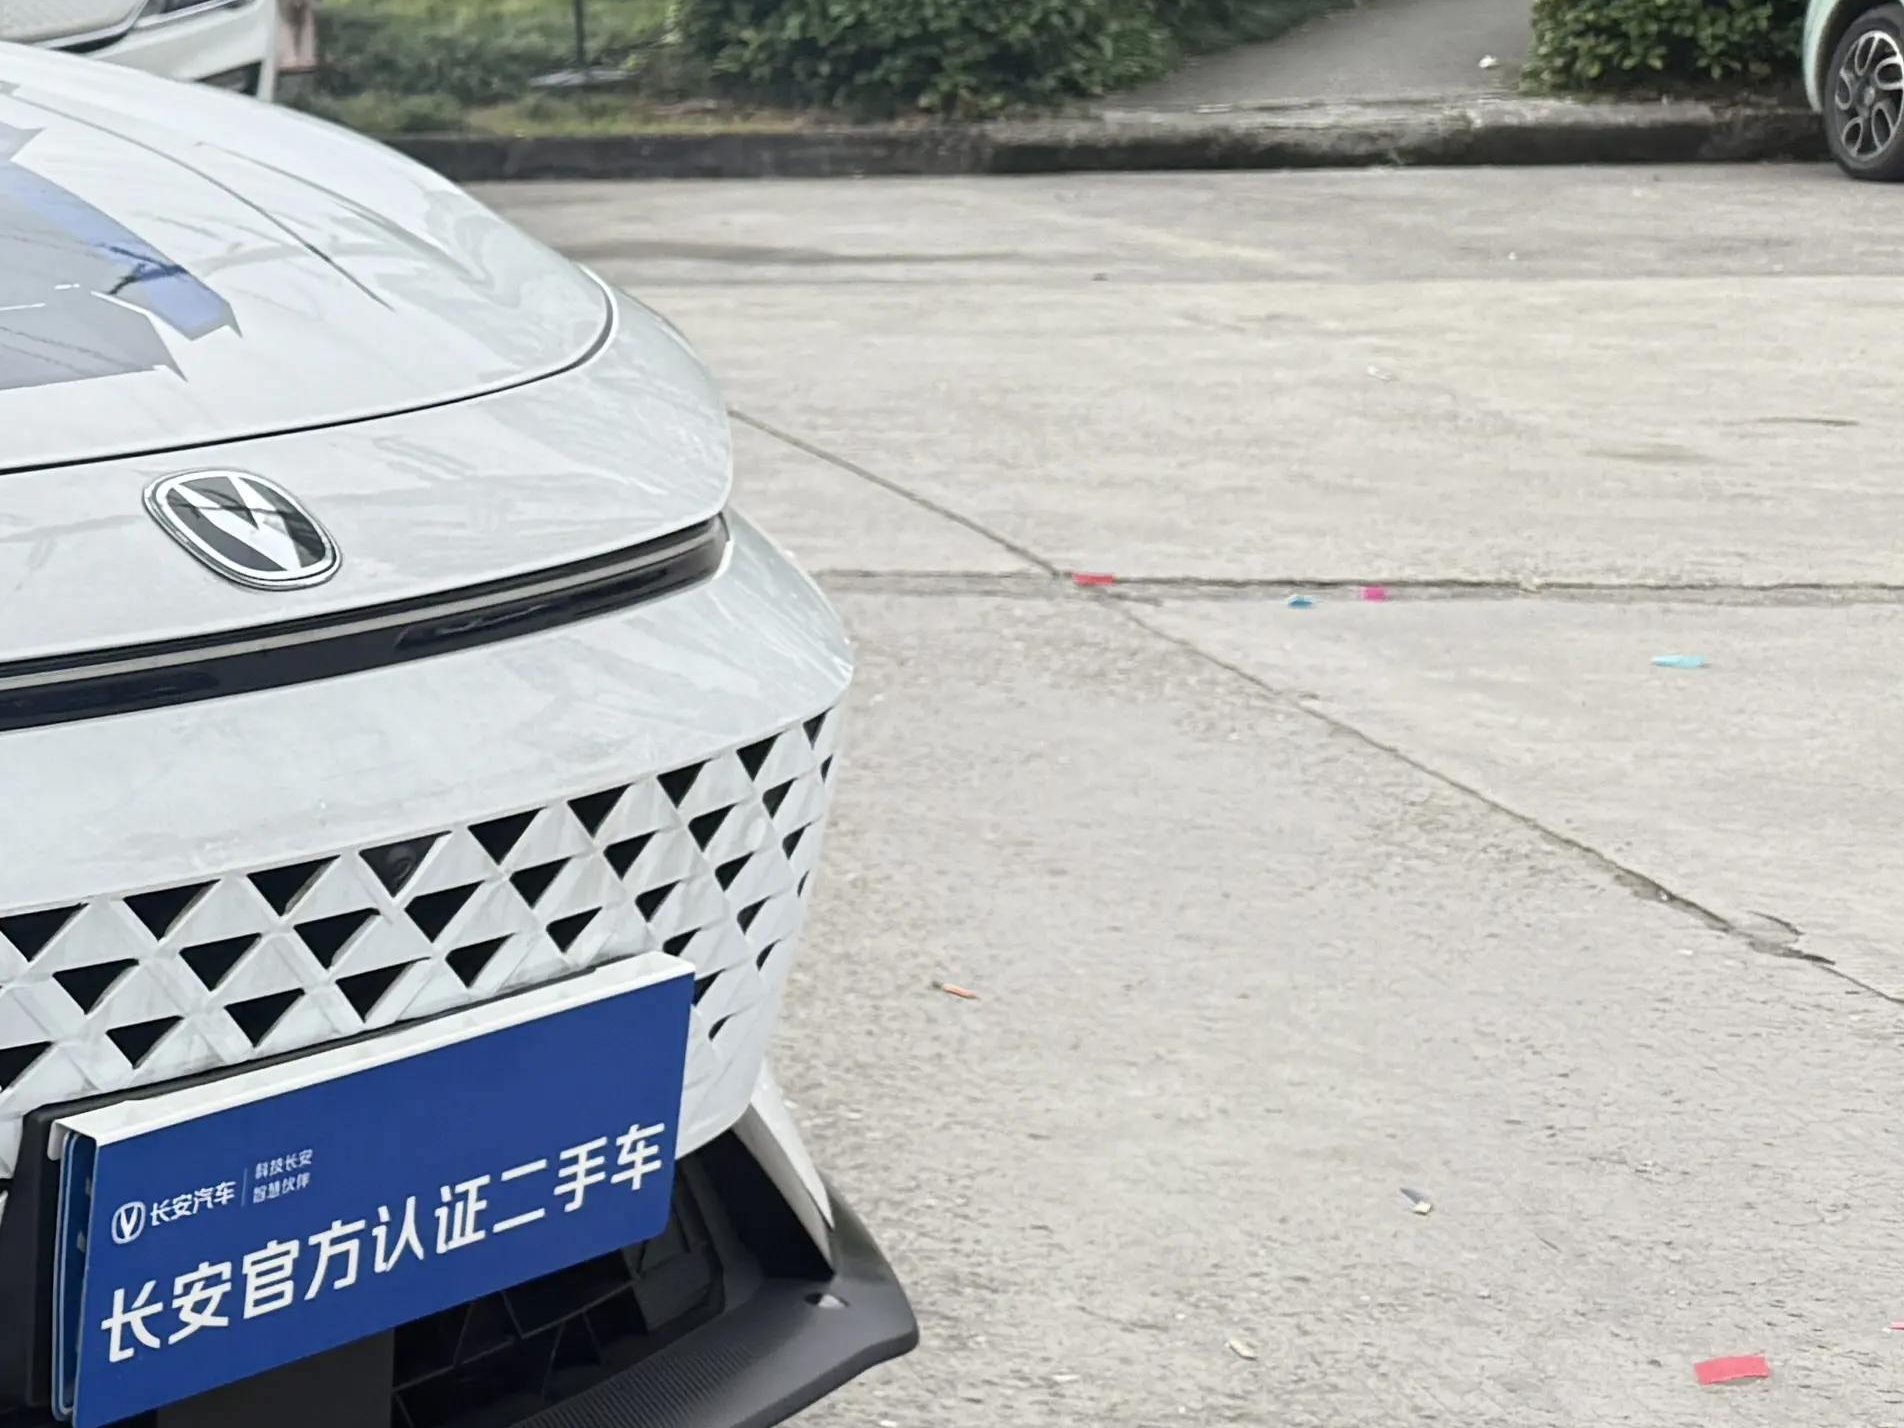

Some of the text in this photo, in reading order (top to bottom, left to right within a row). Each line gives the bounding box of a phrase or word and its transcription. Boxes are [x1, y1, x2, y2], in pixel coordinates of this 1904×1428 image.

[254, 1148, 314, 1180] 科技长安
[150, 1180, 237, 1226] 长安汽车
[252, 1172, 311, 1204] 智慧伙伴
[100, 1122, 665, 1363] 长安官方认证二手车
